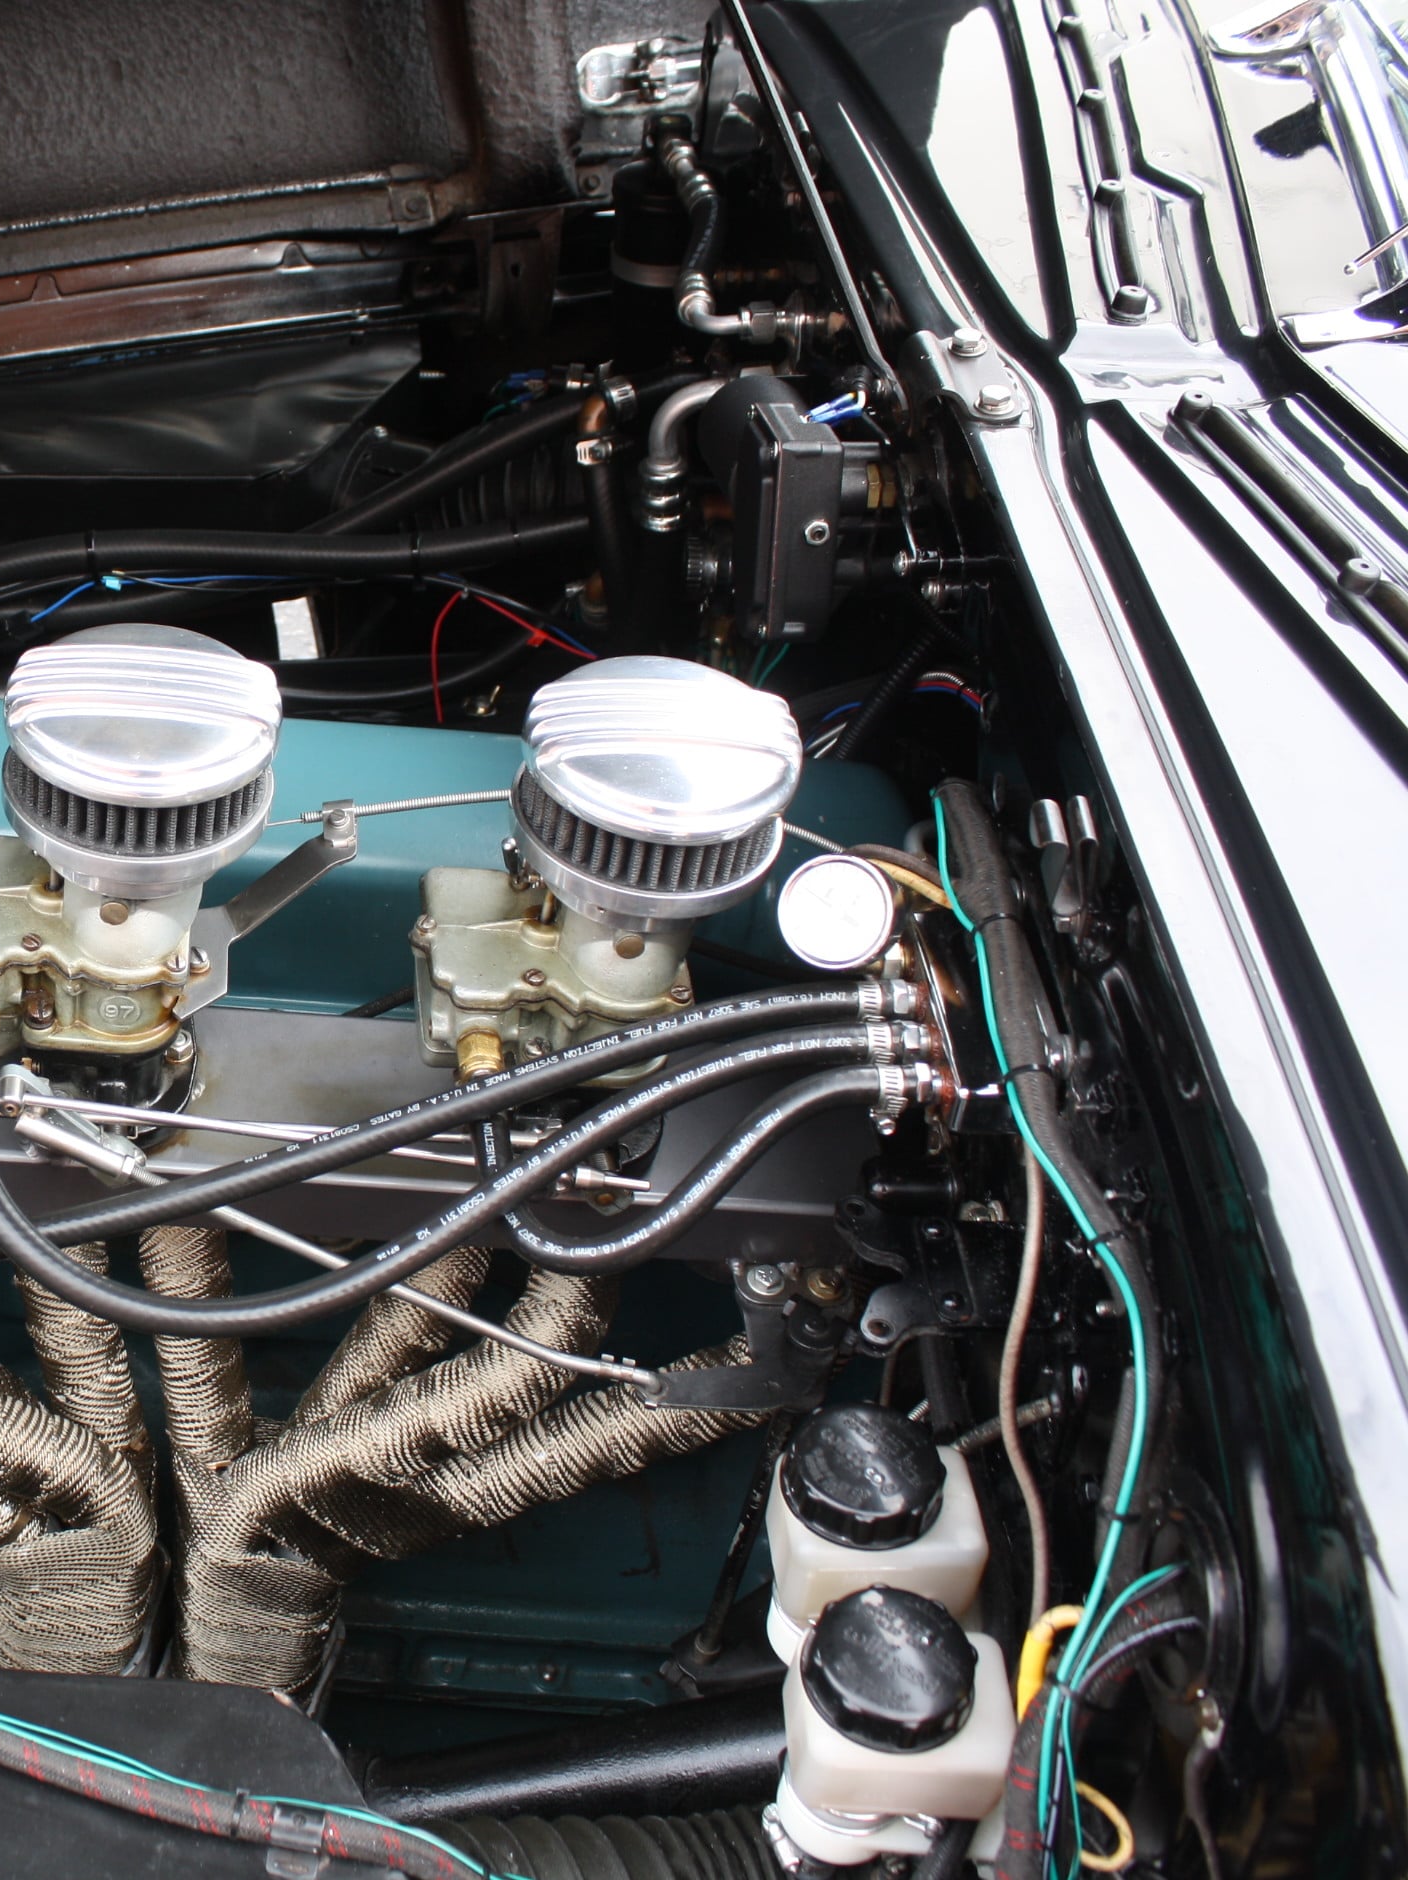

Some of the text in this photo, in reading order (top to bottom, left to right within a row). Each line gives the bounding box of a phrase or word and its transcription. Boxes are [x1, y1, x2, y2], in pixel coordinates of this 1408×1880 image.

[820, 991, 847, 1002] INCH
[105, 1004, 134, 1019] 97
[738, 1001, 761, 1013] SAE
[654, 1019, 678, 1033] FOR
[683, 1011, 705, 1025] NOT
[624, 1024, 652, 1039] FUEL
[561, 1035, 620, 1060] INJECTION
[771, 1041, 796, 1056] FOR
[799, 1038, 821, 1050] NOT
[738, 1046, 767, 1062] FUEL
[514, 1055, 559, 1077] SYSTEMS
[675, 1057, 735, 1084] INJECTION
[485, 1071, 511, 1087] MADE
[466, 1083, 480, 1093] IN
[627, 1080, 672, 1108] SYSTEMS
[425, 1089, 463, 1106] U.S.A.
[406, 1103, 420, 1114] BY
[599, 1103, 626, 1122] MADE
[369, 1110, 402, 1126] GATES
[755, 1108, 782, 1130] FUEL
[581, 1120, 596, 1134] IN
[482, 1121, 497, 1167] INJECTION
[543, 1130, 580, 1154] U.S.A.
[727, 1131, 758, 1161] VAPOR
[527, 1154, 542, 1171] BY
[492, 1167, 524, 1192] GATES
[652, 1206, 679, 1231] 5/16
[416, 1226, 433, 1241] X2
[622, 1227, 651, 1248] INCH
[542, 1239, 563, 1256] SAE
